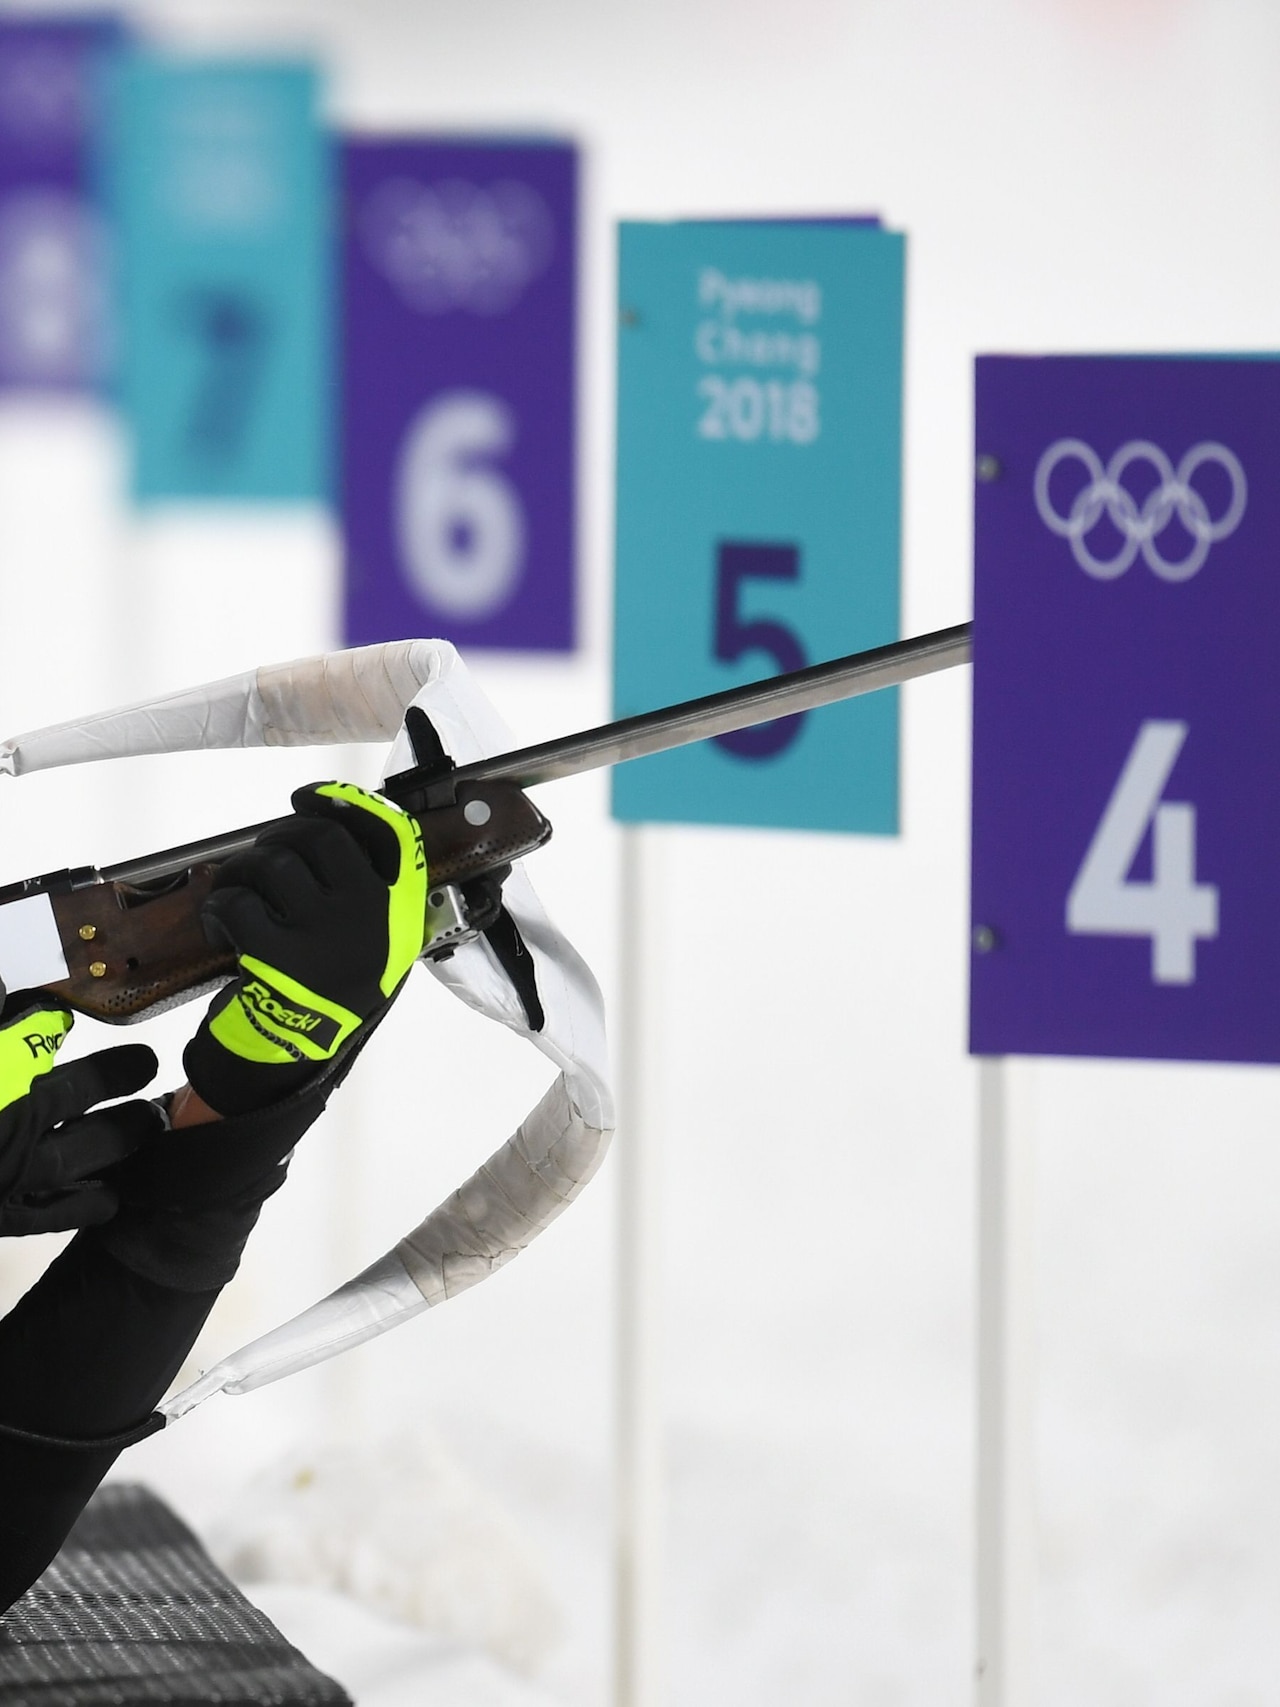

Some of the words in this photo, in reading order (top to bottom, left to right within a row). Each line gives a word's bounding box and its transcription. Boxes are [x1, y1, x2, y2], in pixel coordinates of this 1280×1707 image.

[176, 284, 273, 468] 7
[696, 321, 820, 377] Chang
[697, 266, 820, 326] Pyeong
[698, 376, 820, 443] 2018
[397, 390, 526, 622] 6
[709, 538, 812, 765] 5
[1065, 719, 1219, 986] 4
